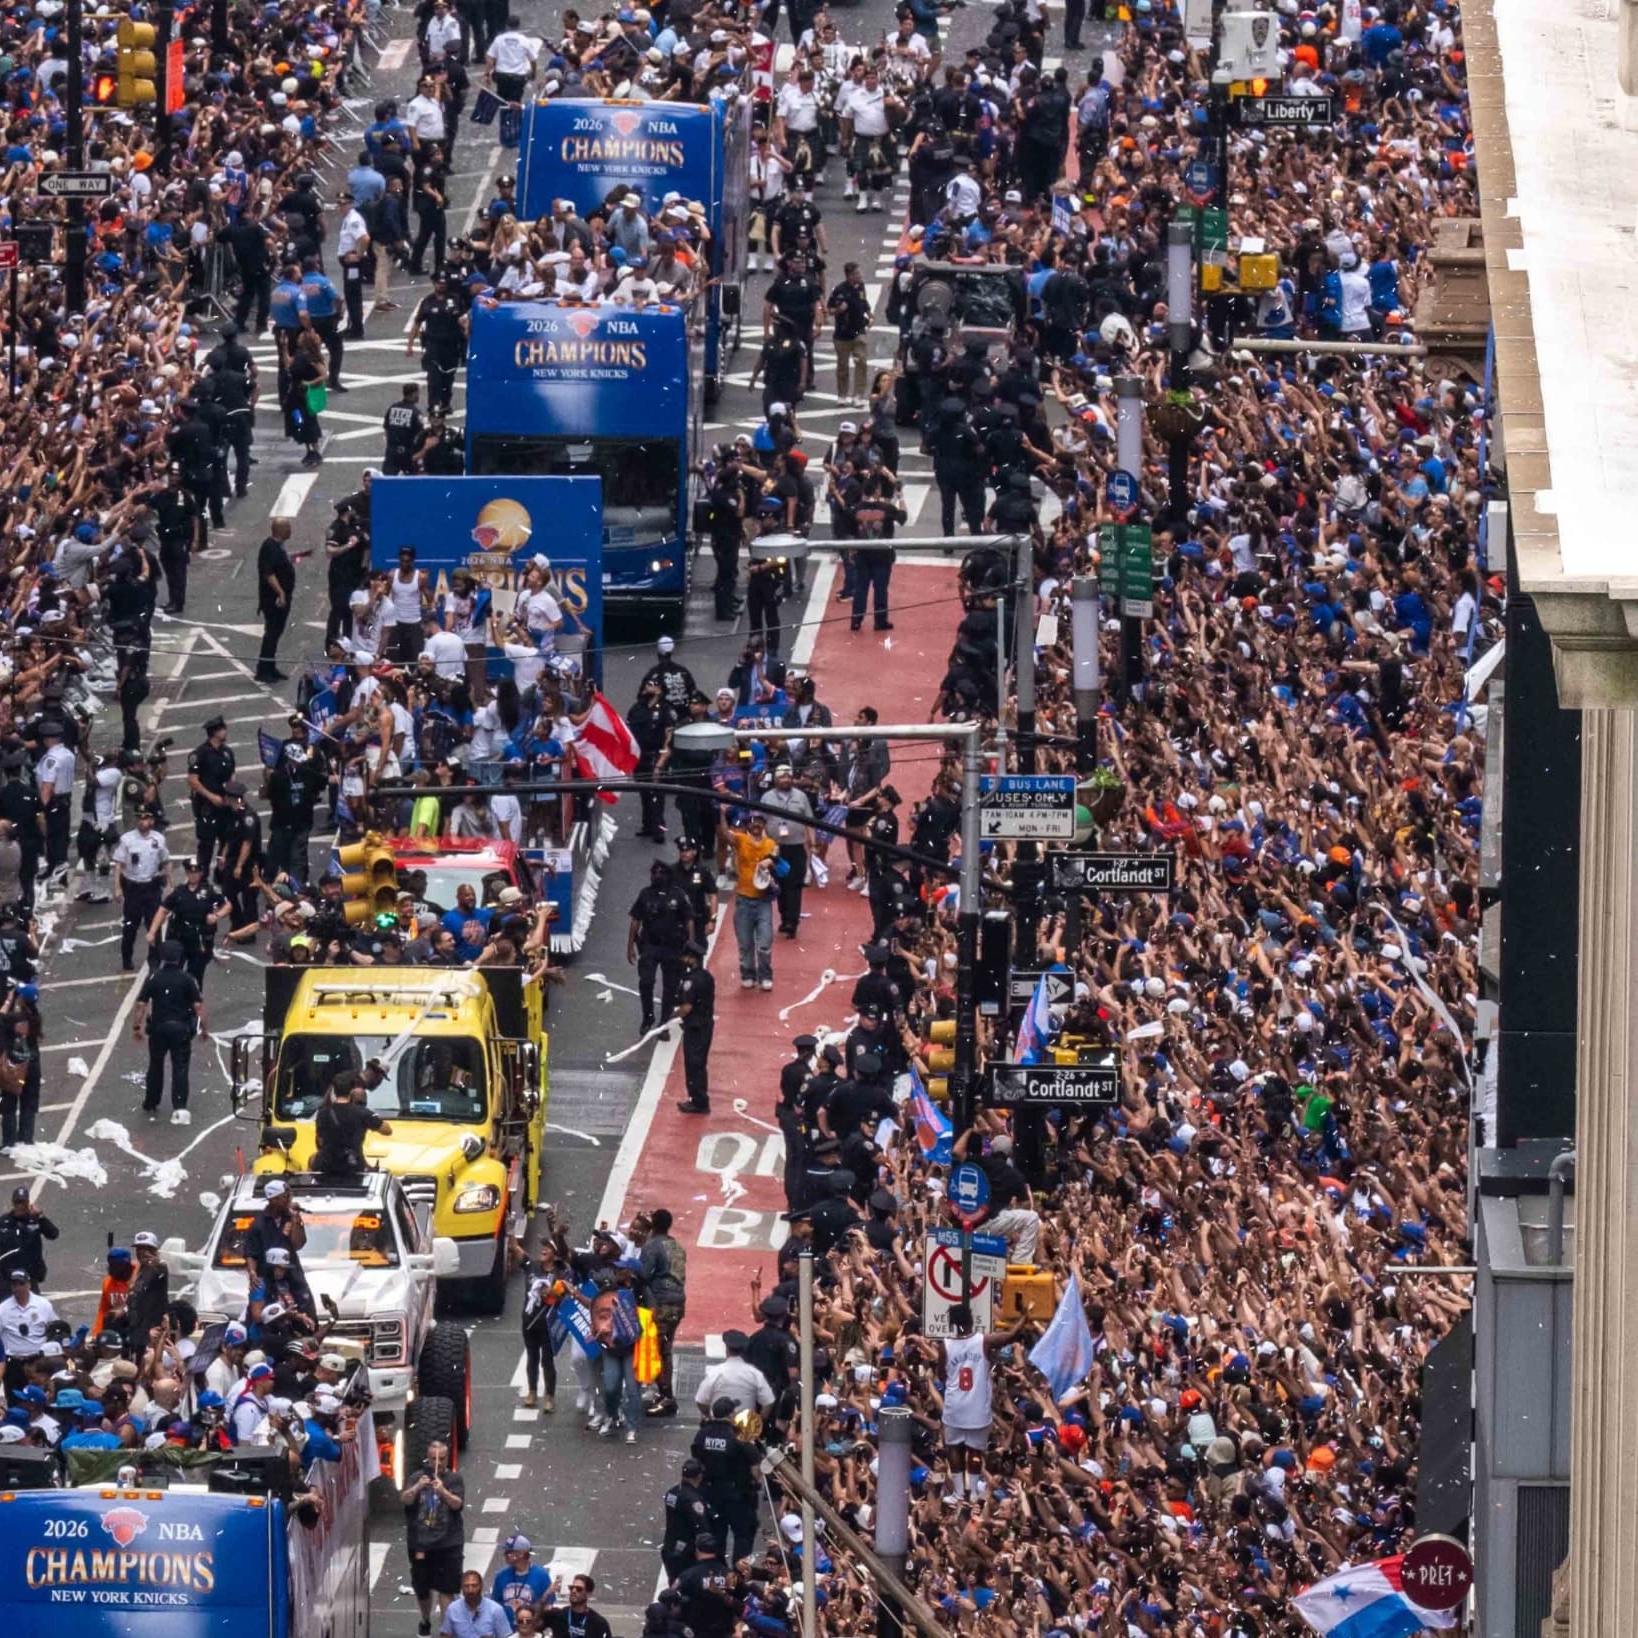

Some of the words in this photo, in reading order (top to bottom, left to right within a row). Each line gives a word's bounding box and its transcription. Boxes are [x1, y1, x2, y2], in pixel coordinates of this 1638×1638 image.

[1266, 103, 1314, 121] Liberty
[1318, 103, 1327, 112] ST
[573, 118, 603, 131] 2026
[648, 121, 678, 134] NBA
[561, 136, 684, 168] CHAMPIONS
[577, 163, 601, 172] NEW
[603, 164, 629, 174] YORK
[631, 165, 668, 175] KNICKS
[48, 179, 70, 191] ONE
[79, 179, 102, 191] WAY
[526, 320, 559, 332] 2026
[607, 322, 639, 334] NBA
[514, 340, 647, 369] CHAMPIONS
[532, 368, 558, 378] NEW
[561, 369, 588, 379] YORK
[590, 370, 629, 380] KNICKS
[1008, 778, 1031, 789] BUS
[1035, 778, 1066, 790] LANE
[990, 792, 1030, 803] USES
[1035, 793, 1067, 803] ONLY
[1086, 866, 1154, 884] Cortlandt
[1154, 868, 1165, 879] ST
[1028, 1078, 1100, 1098] Cortlandt
[1102, 1081, 1113, 1092] ST
[938, 1231, 960, 1245] M55
[929, 1325, 952, 1334] OVE
[959, 1366, 973, 1392] 8
[705, 1437, 727, 1449] NYPD
[43, 1519, 89, 1538] 2026
[158, 1523, 204, 1541] NBA
[26, 1546, 215, 1594] CHAMPIONS
[51, 1589, 86, 1602] NEW
[91, 1591, 129, 1604] YORK
[134, 1592, 189, 1605] KNICKS
